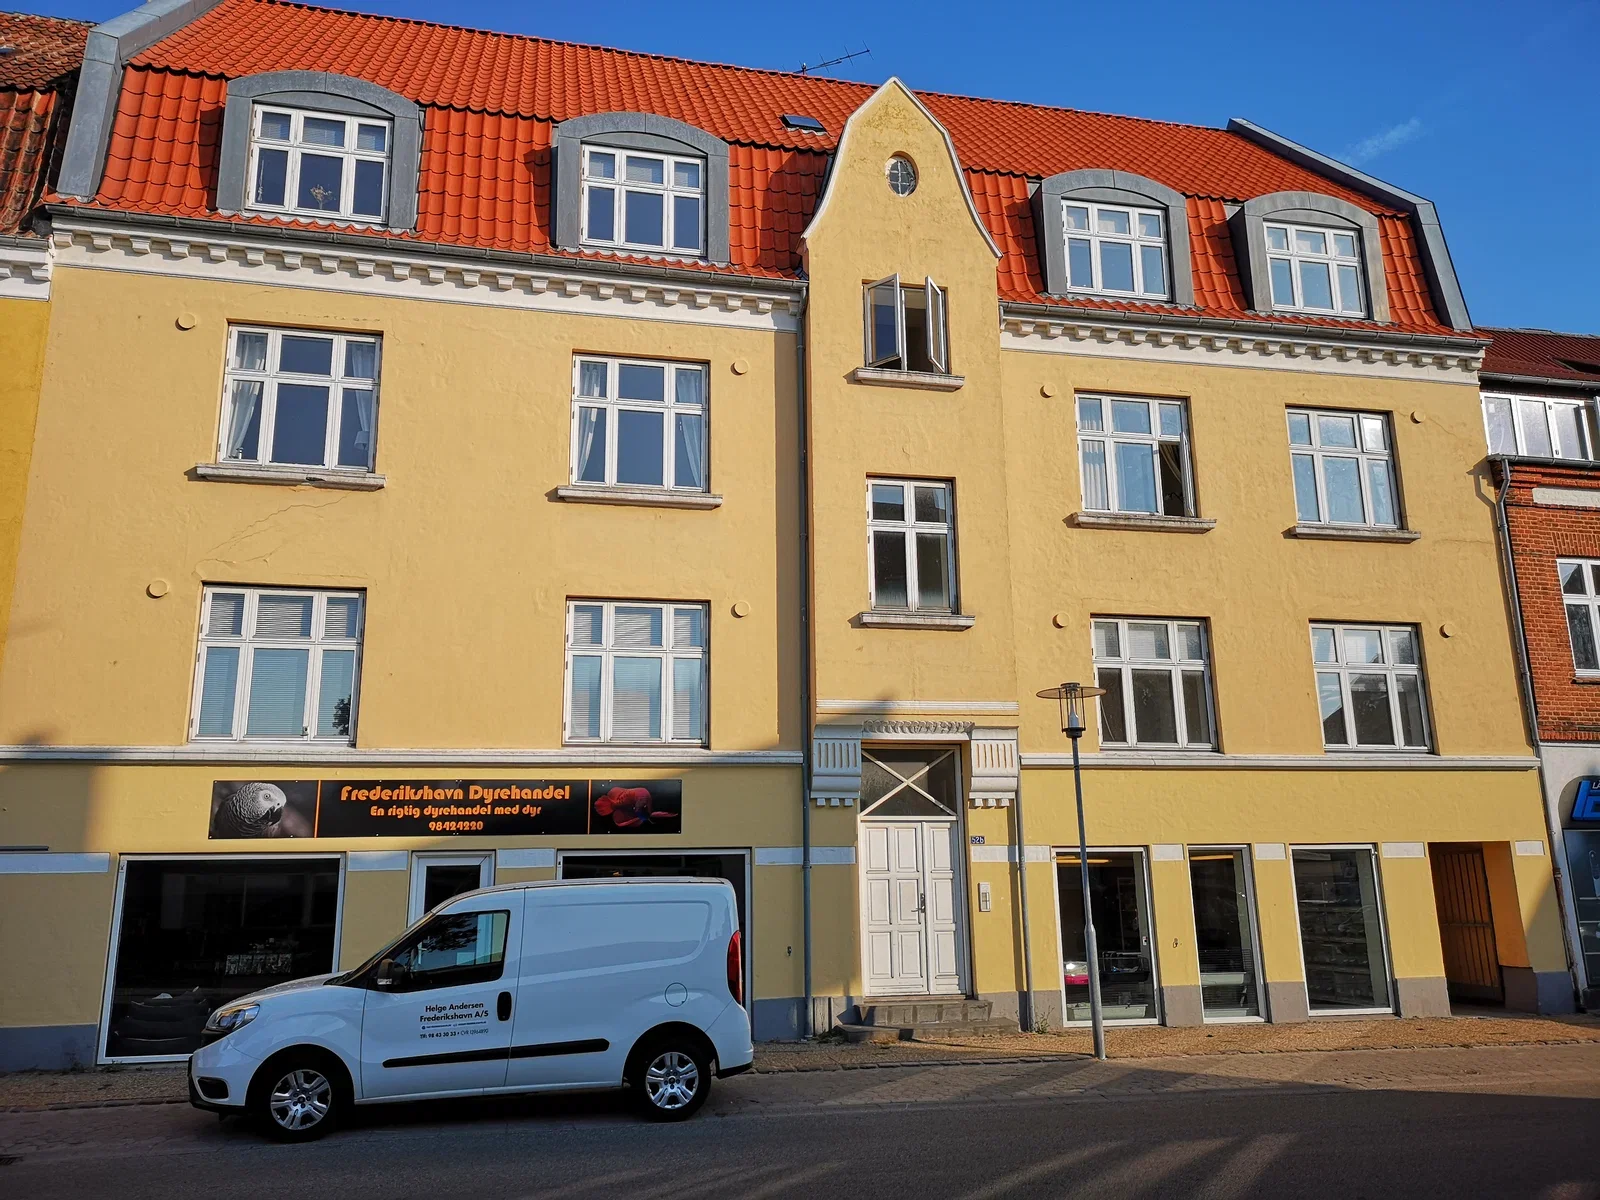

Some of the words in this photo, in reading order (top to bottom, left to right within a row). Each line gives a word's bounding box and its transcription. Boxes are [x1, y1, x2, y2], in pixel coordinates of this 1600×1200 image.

[340, 785, 464, 801] Frederikshavn
[468, 785, 570, 804] Dyrehandel
[370, 805, 385, 816] En
[388, 805, 421, 819] rigtig
[423, 804, 492, 818] dyrehandel
[494, 804, 520, 815] med
[522, 804, 542, 817] dyr
[428, 821, 484, 831] 98424220
[425, 1005, 447, 1013] Helge
[449, 1002, 484, 1011] Andersen
[419, 1012, 473, 1022] Frederikshavn
[474, 1010, 489, 1018] A/S
